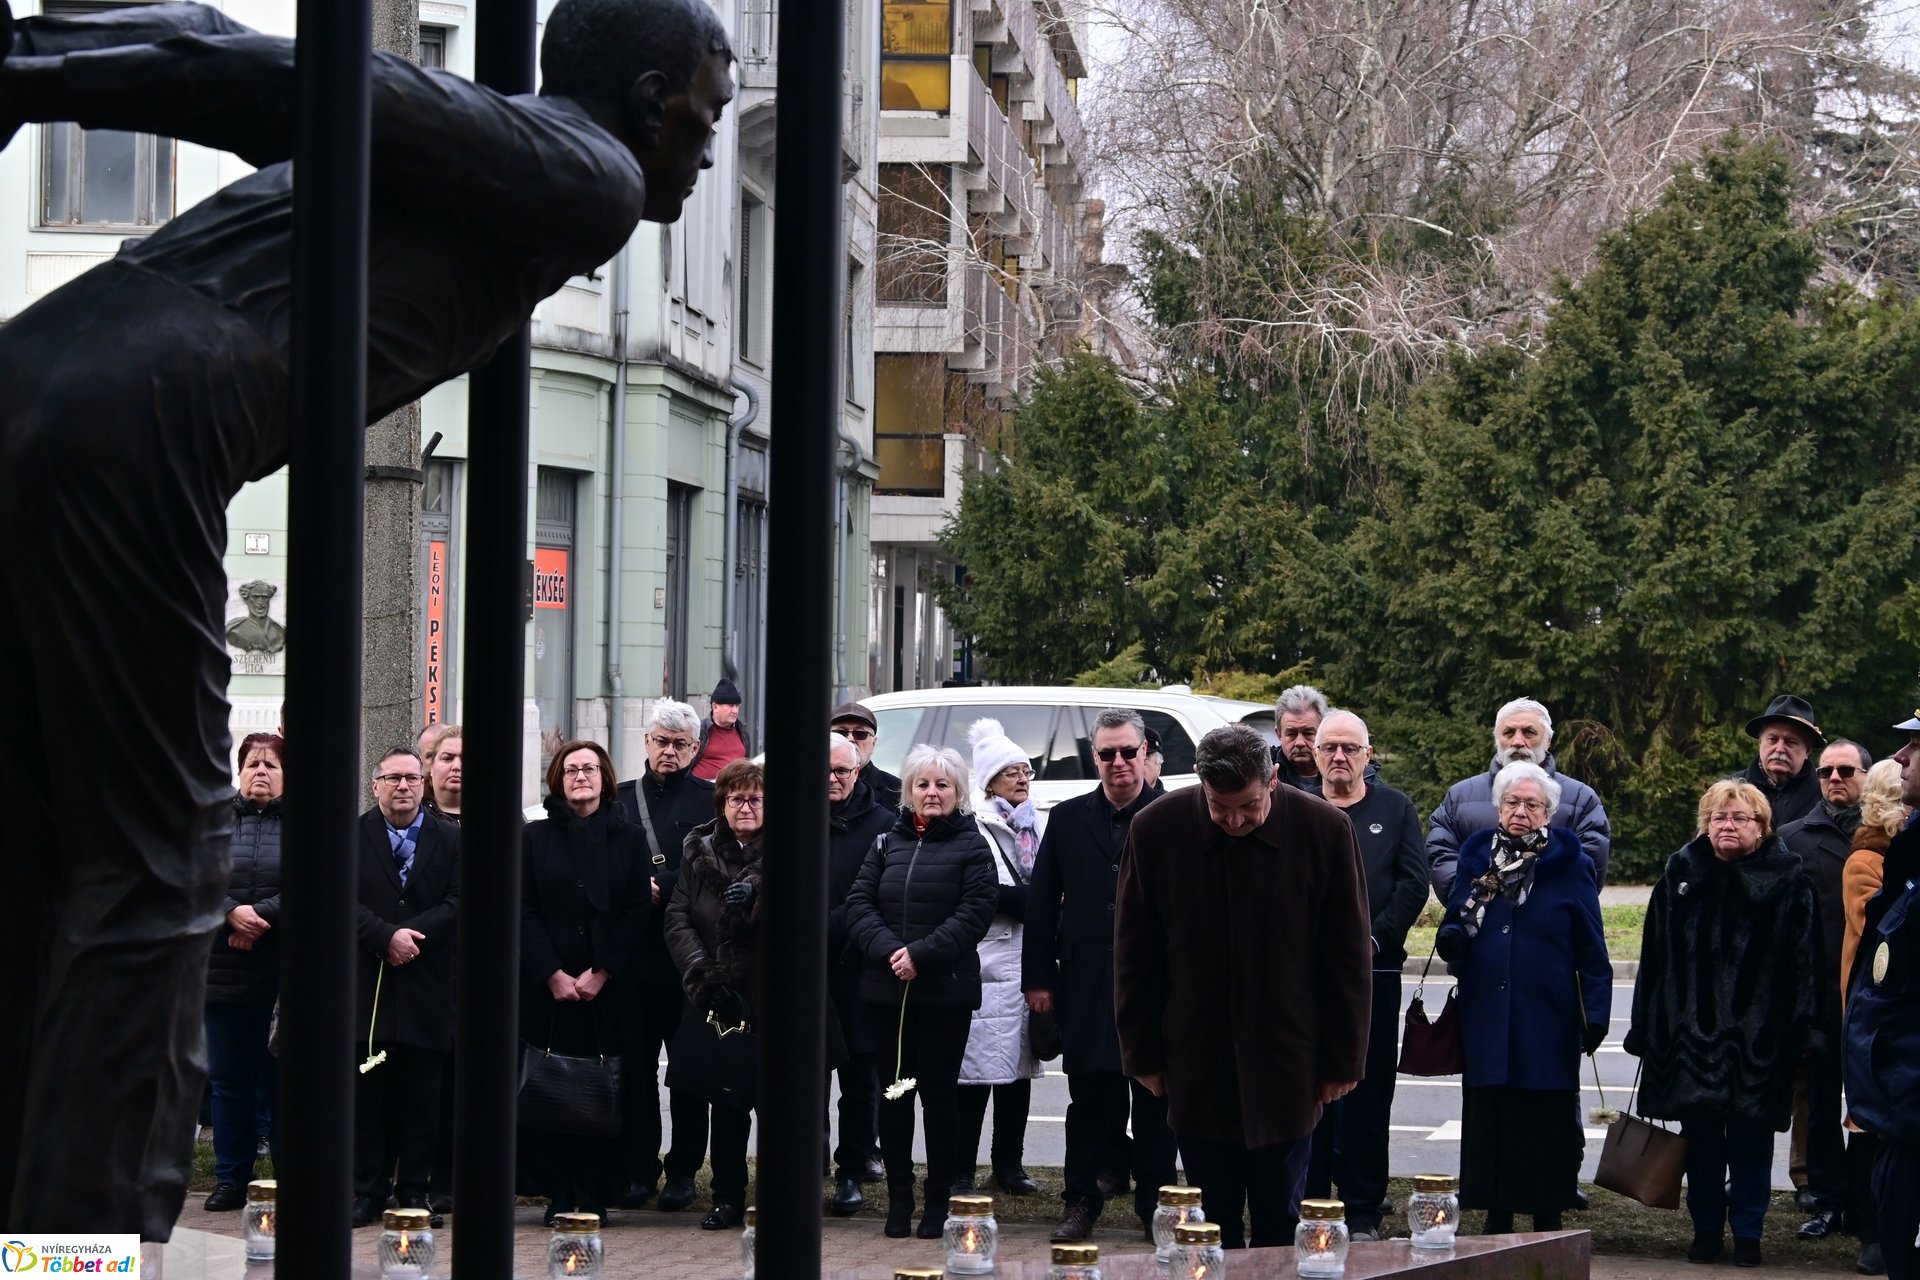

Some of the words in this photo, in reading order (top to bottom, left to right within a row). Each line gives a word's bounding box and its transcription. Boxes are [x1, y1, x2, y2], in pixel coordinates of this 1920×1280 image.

[431, 551, 440, 606] LEONI
[536, 568, 564, 603] ÉKSÉG
[245, 664, 264, 673] UTCA
[428, 620, 439, 726] PÉKSÉ
